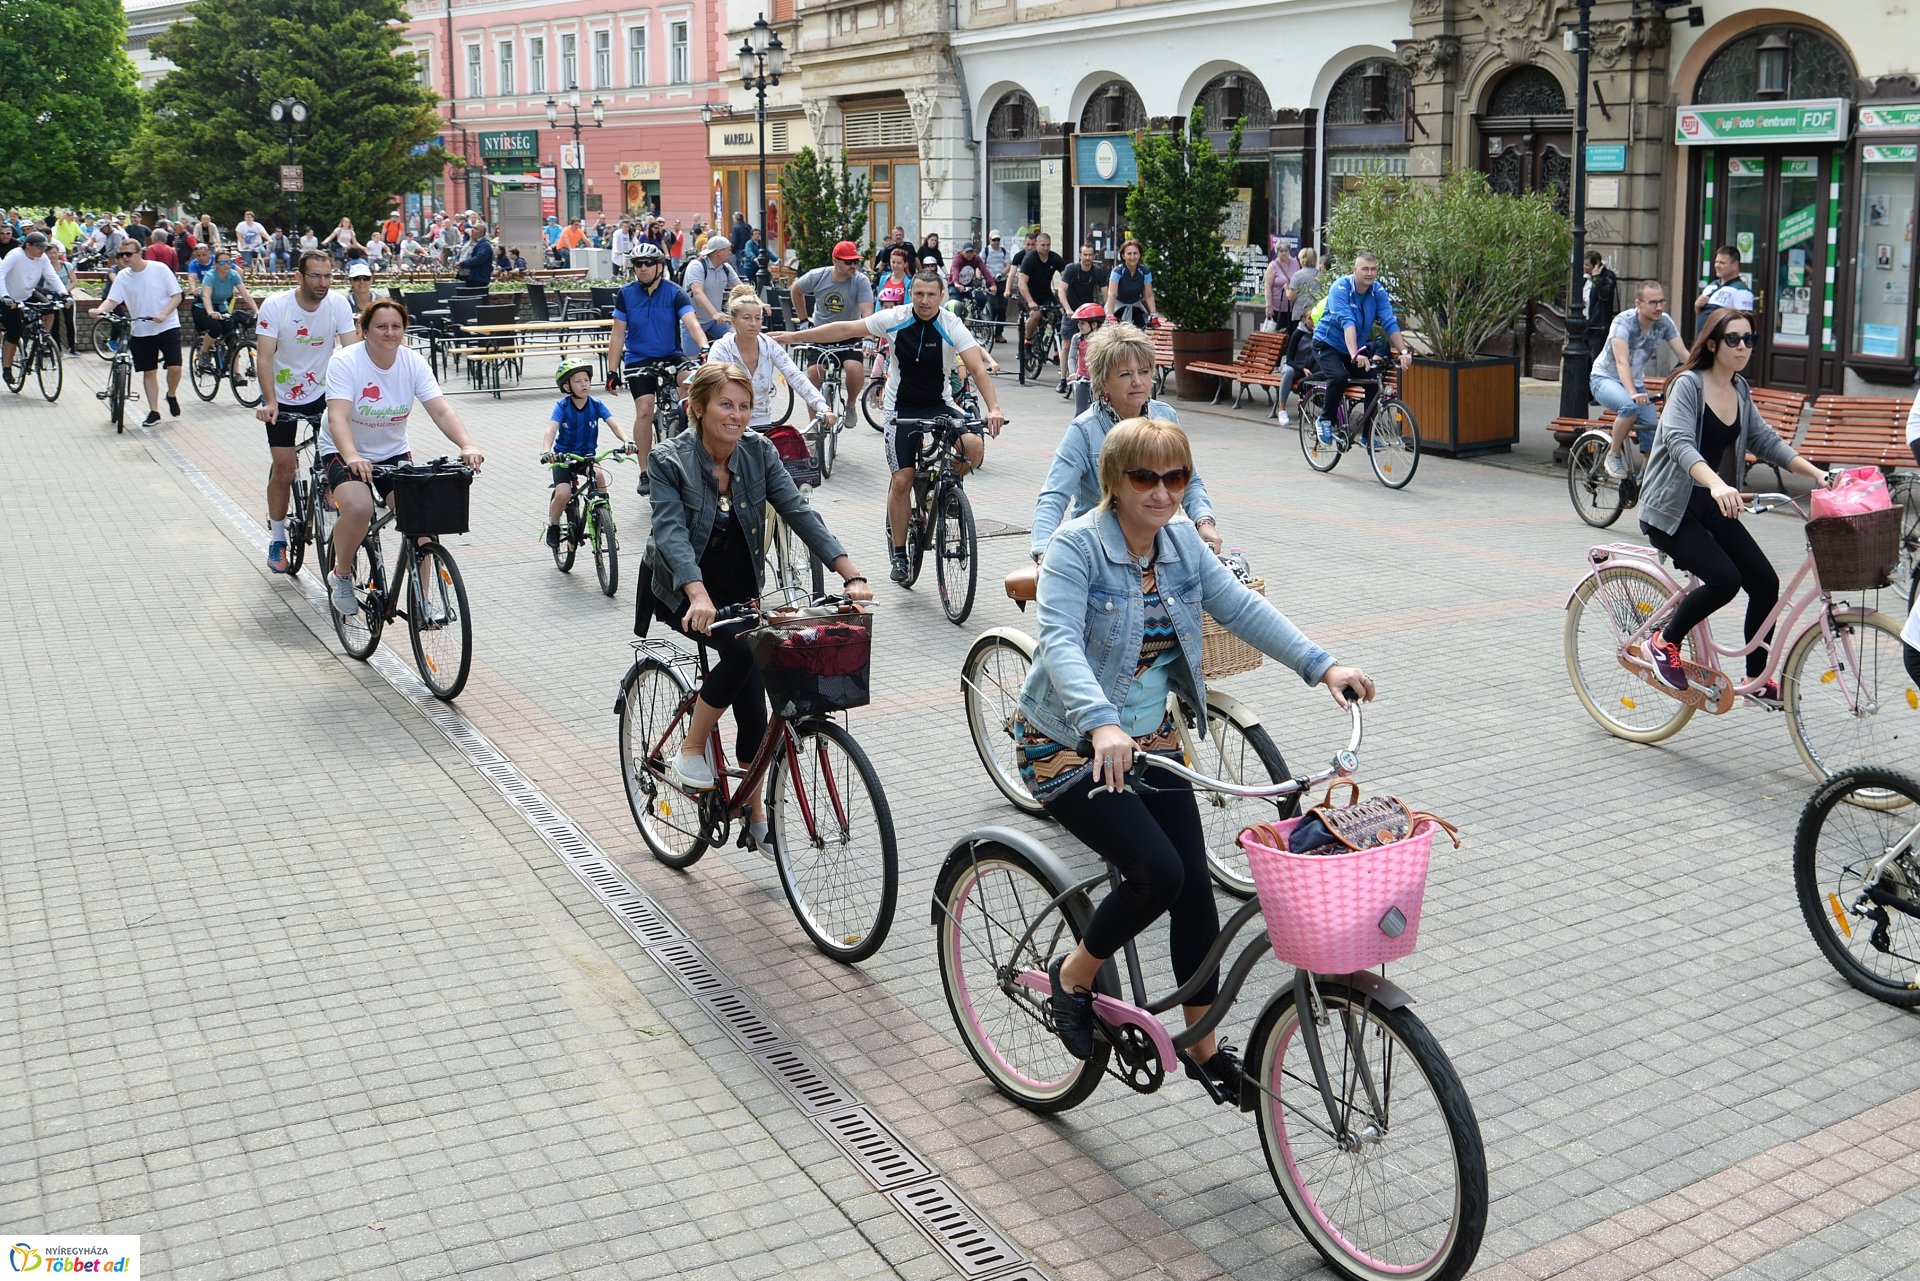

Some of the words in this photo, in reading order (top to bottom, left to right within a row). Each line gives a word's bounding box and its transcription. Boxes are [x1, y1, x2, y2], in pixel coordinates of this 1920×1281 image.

[1733, 117, 1754, 128] Foto
[1756, 116, 1796, 128] Centrum
[1801, 112, 1833, 127] FDF
[724, 133, 754, 145] MARELLA
[1790, 161, 1806, 170] FDF
